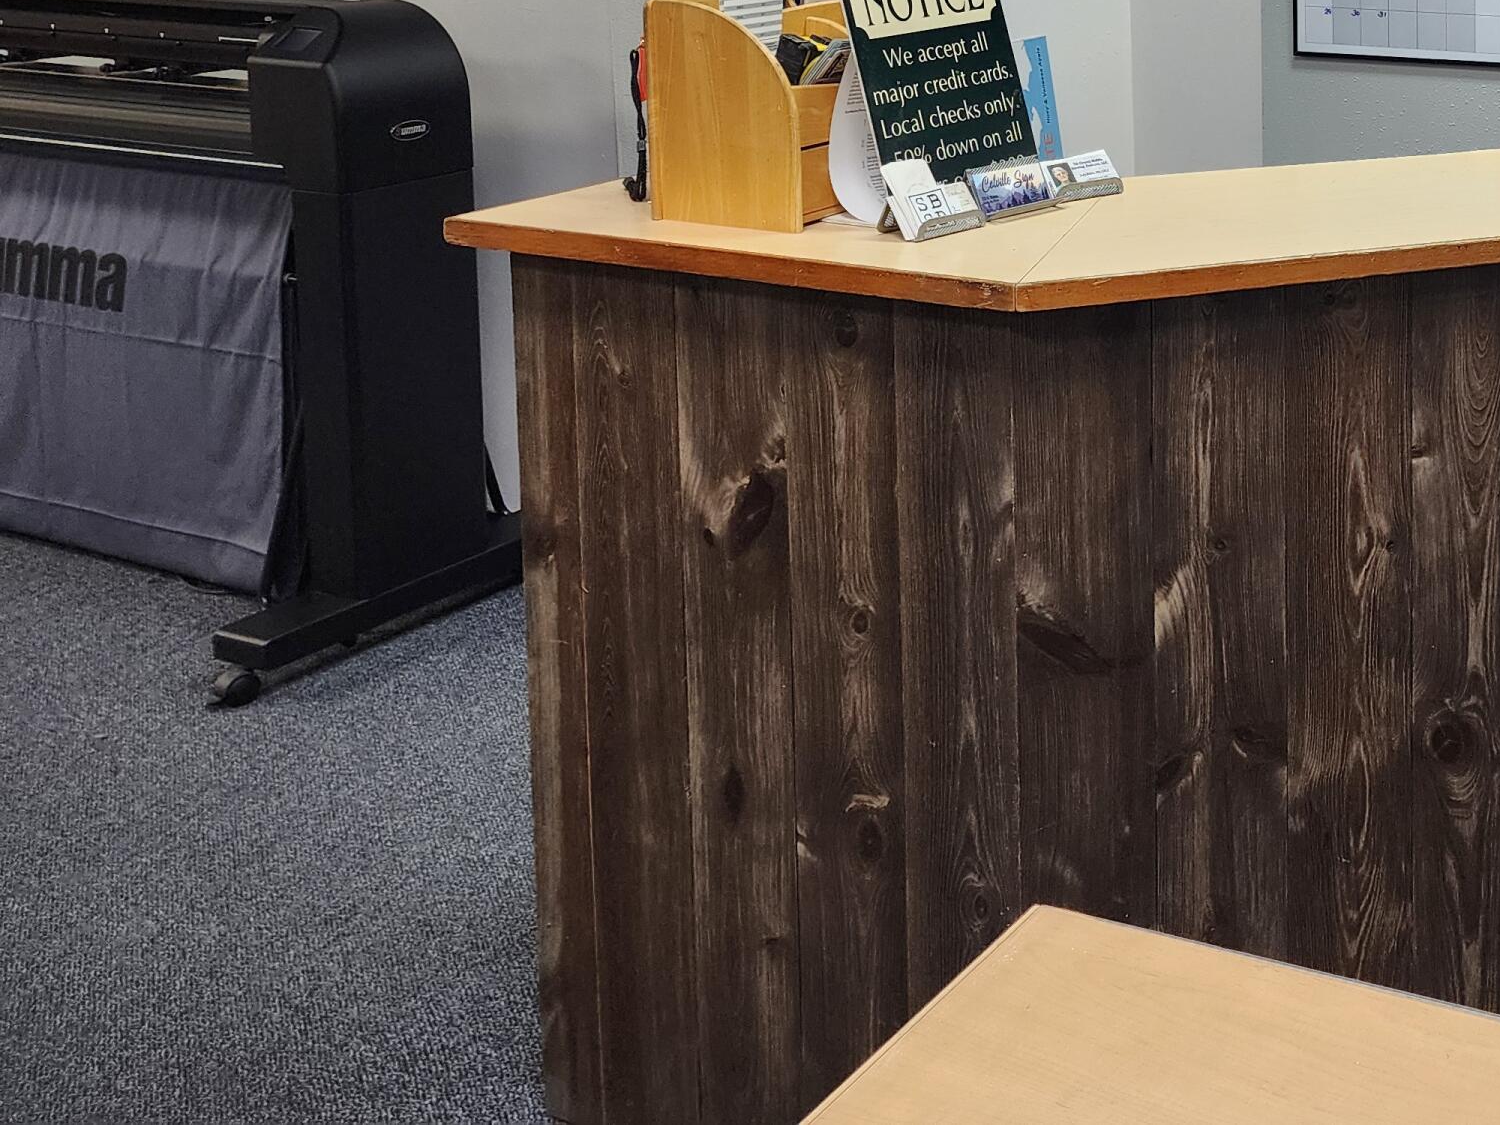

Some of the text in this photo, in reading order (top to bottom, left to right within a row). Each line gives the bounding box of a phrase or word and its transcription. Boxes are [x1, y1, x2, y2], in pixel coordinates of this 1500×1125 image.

[882, 31, 989, 68] We accept all
[873, 81, 919, 107] major
[924, 70, 969, 95] credit
[971, 61, 1013, 86] cards.
[880, 92, 1021, 140] Local checks only.
[936, 138, 979, 161] down
[983, 132, 1002, 149] on
[1006, 121, 1023, 143] all
[1013, 170, 1034, 189] Sign
[0, 237, 127, 312] mma
